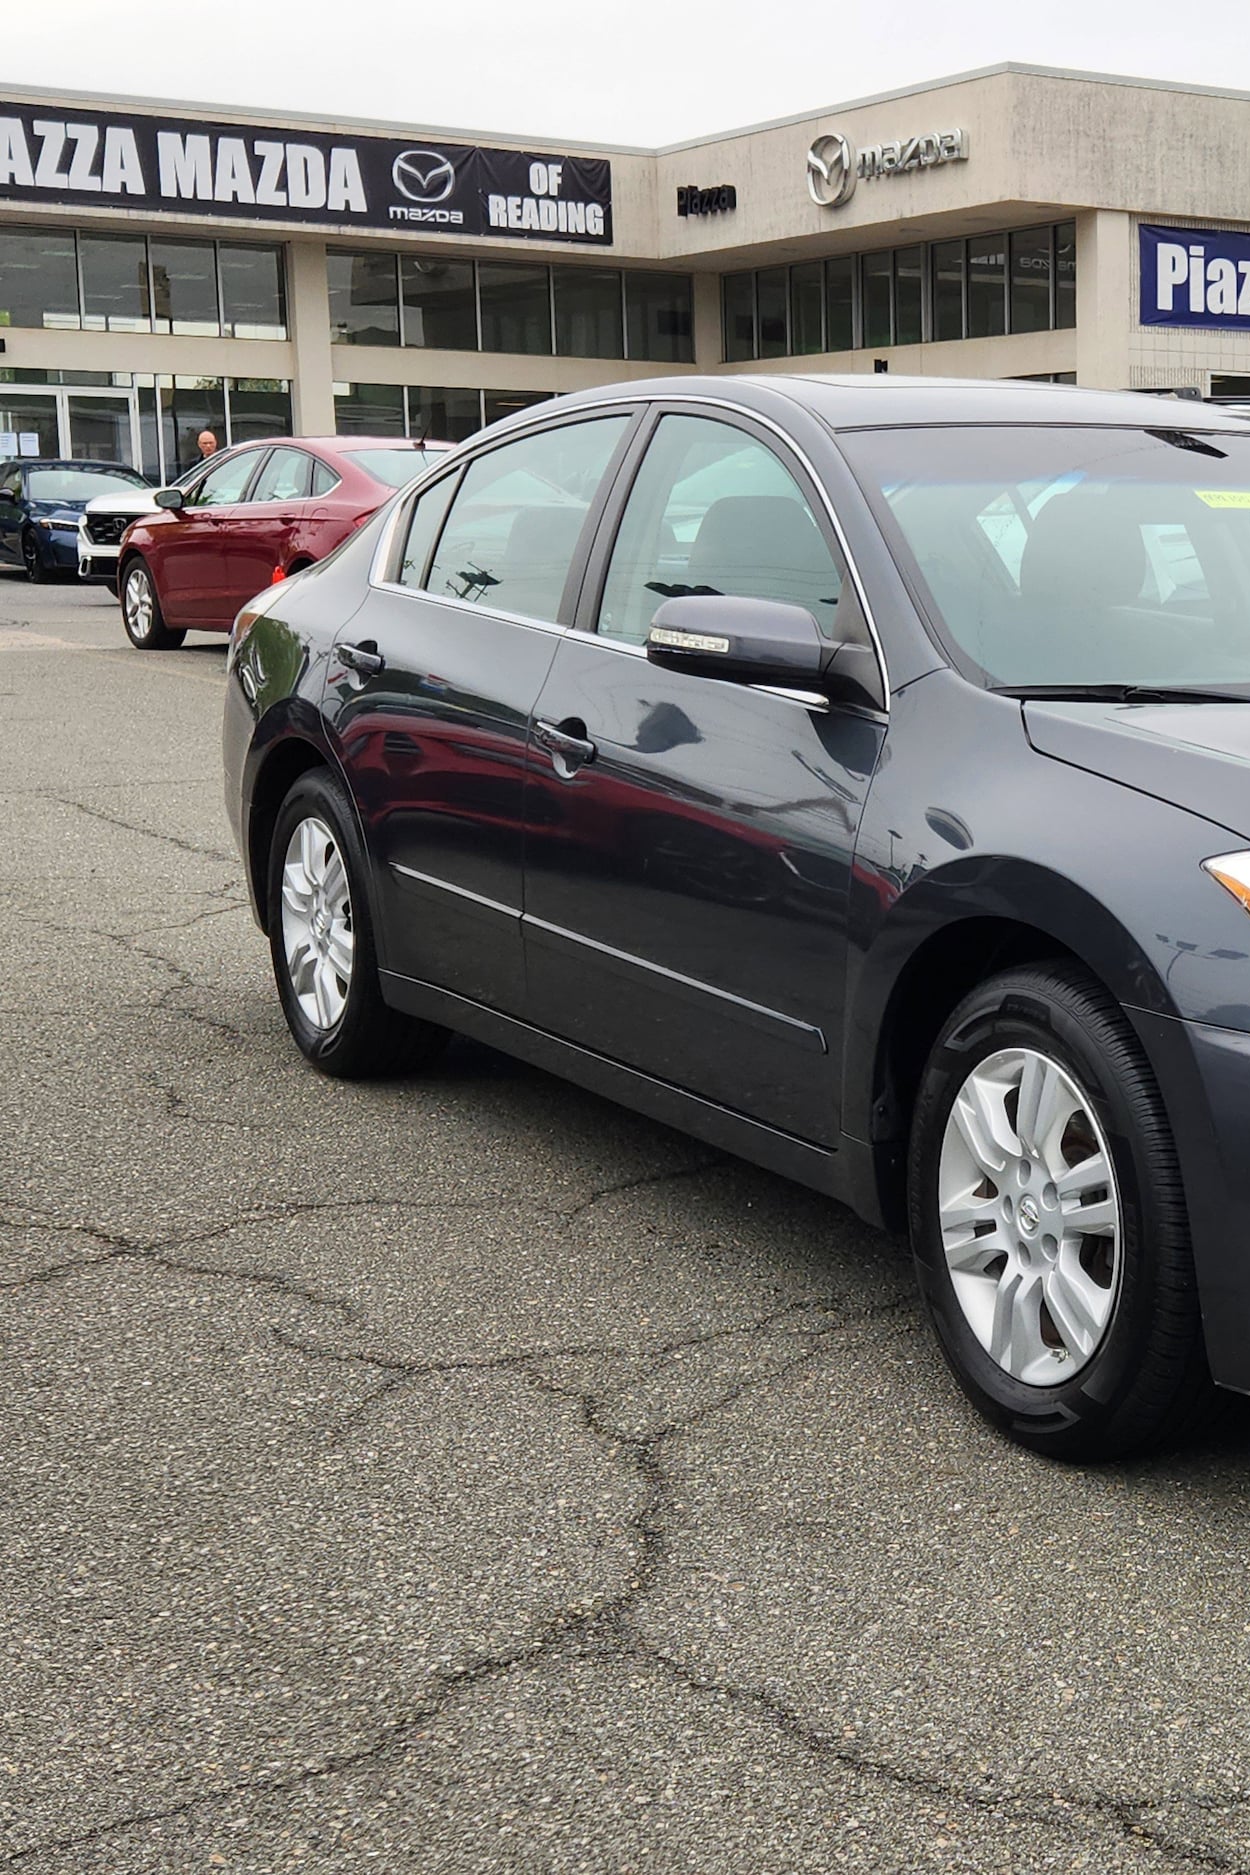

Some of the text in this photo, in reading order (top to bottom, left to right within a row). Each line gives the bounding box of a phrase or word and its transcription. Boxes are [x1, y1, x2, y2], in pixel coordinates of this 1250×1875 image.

[157, 131, 368, 213] MAZDA
[855, 127, 970, 181] mazda
[528, 161, 564, 197] OF
[388, 204, 464, 225] mazda
[488, 195, 606, 236] READING
